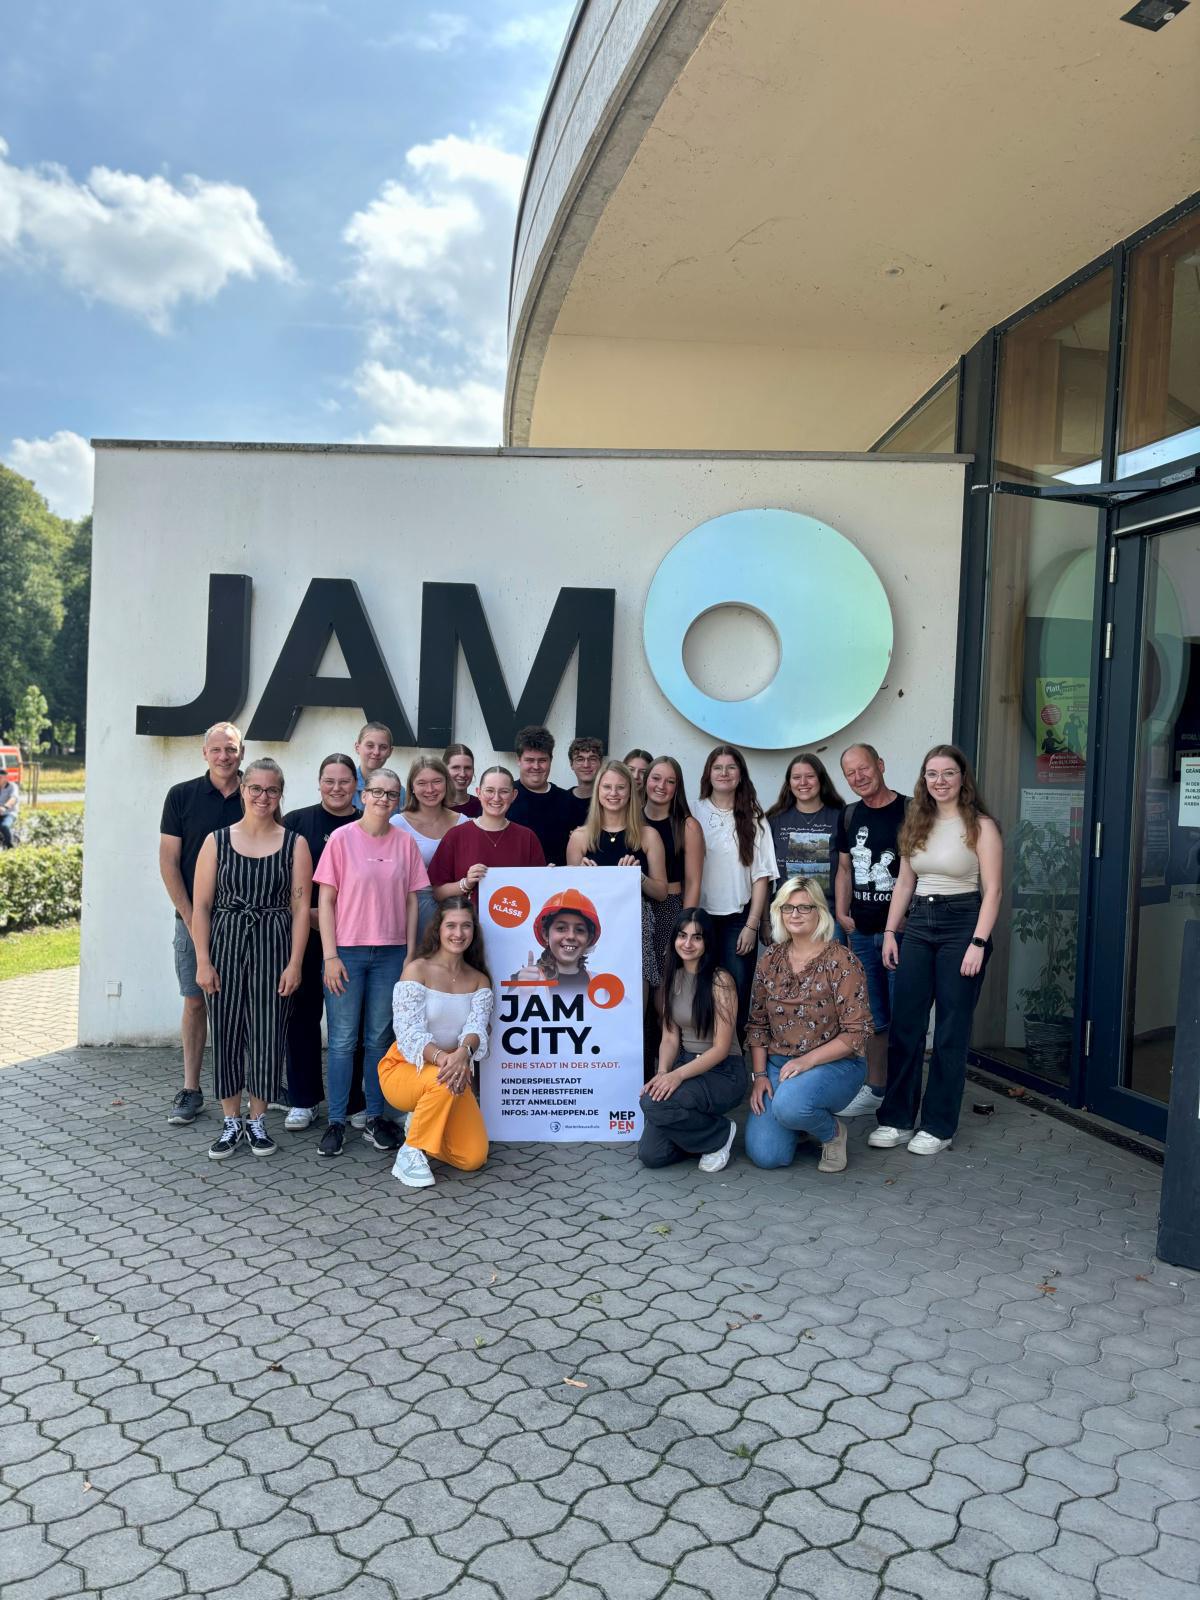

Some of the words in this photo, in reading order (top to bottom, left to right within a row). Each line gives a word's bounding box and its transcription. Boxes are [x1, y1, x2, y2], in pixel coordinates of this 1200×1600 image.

[136, 573, 617, 754] JAM
[862, 891, 871, 901] BE
[873, 892, 892, 902] COO
[493, 903, 523, 918] KLASSE
[499, 994, 584, 1022] JAM
[501, 1026, 600, 1055] CITY.
[501, 1062, 528, 1070] DEINE
[591, 1061, 621, 1069] STADT.
[609, 1111, 636, 1120] MEP
[609, 1120, 635, 1130] PEN
